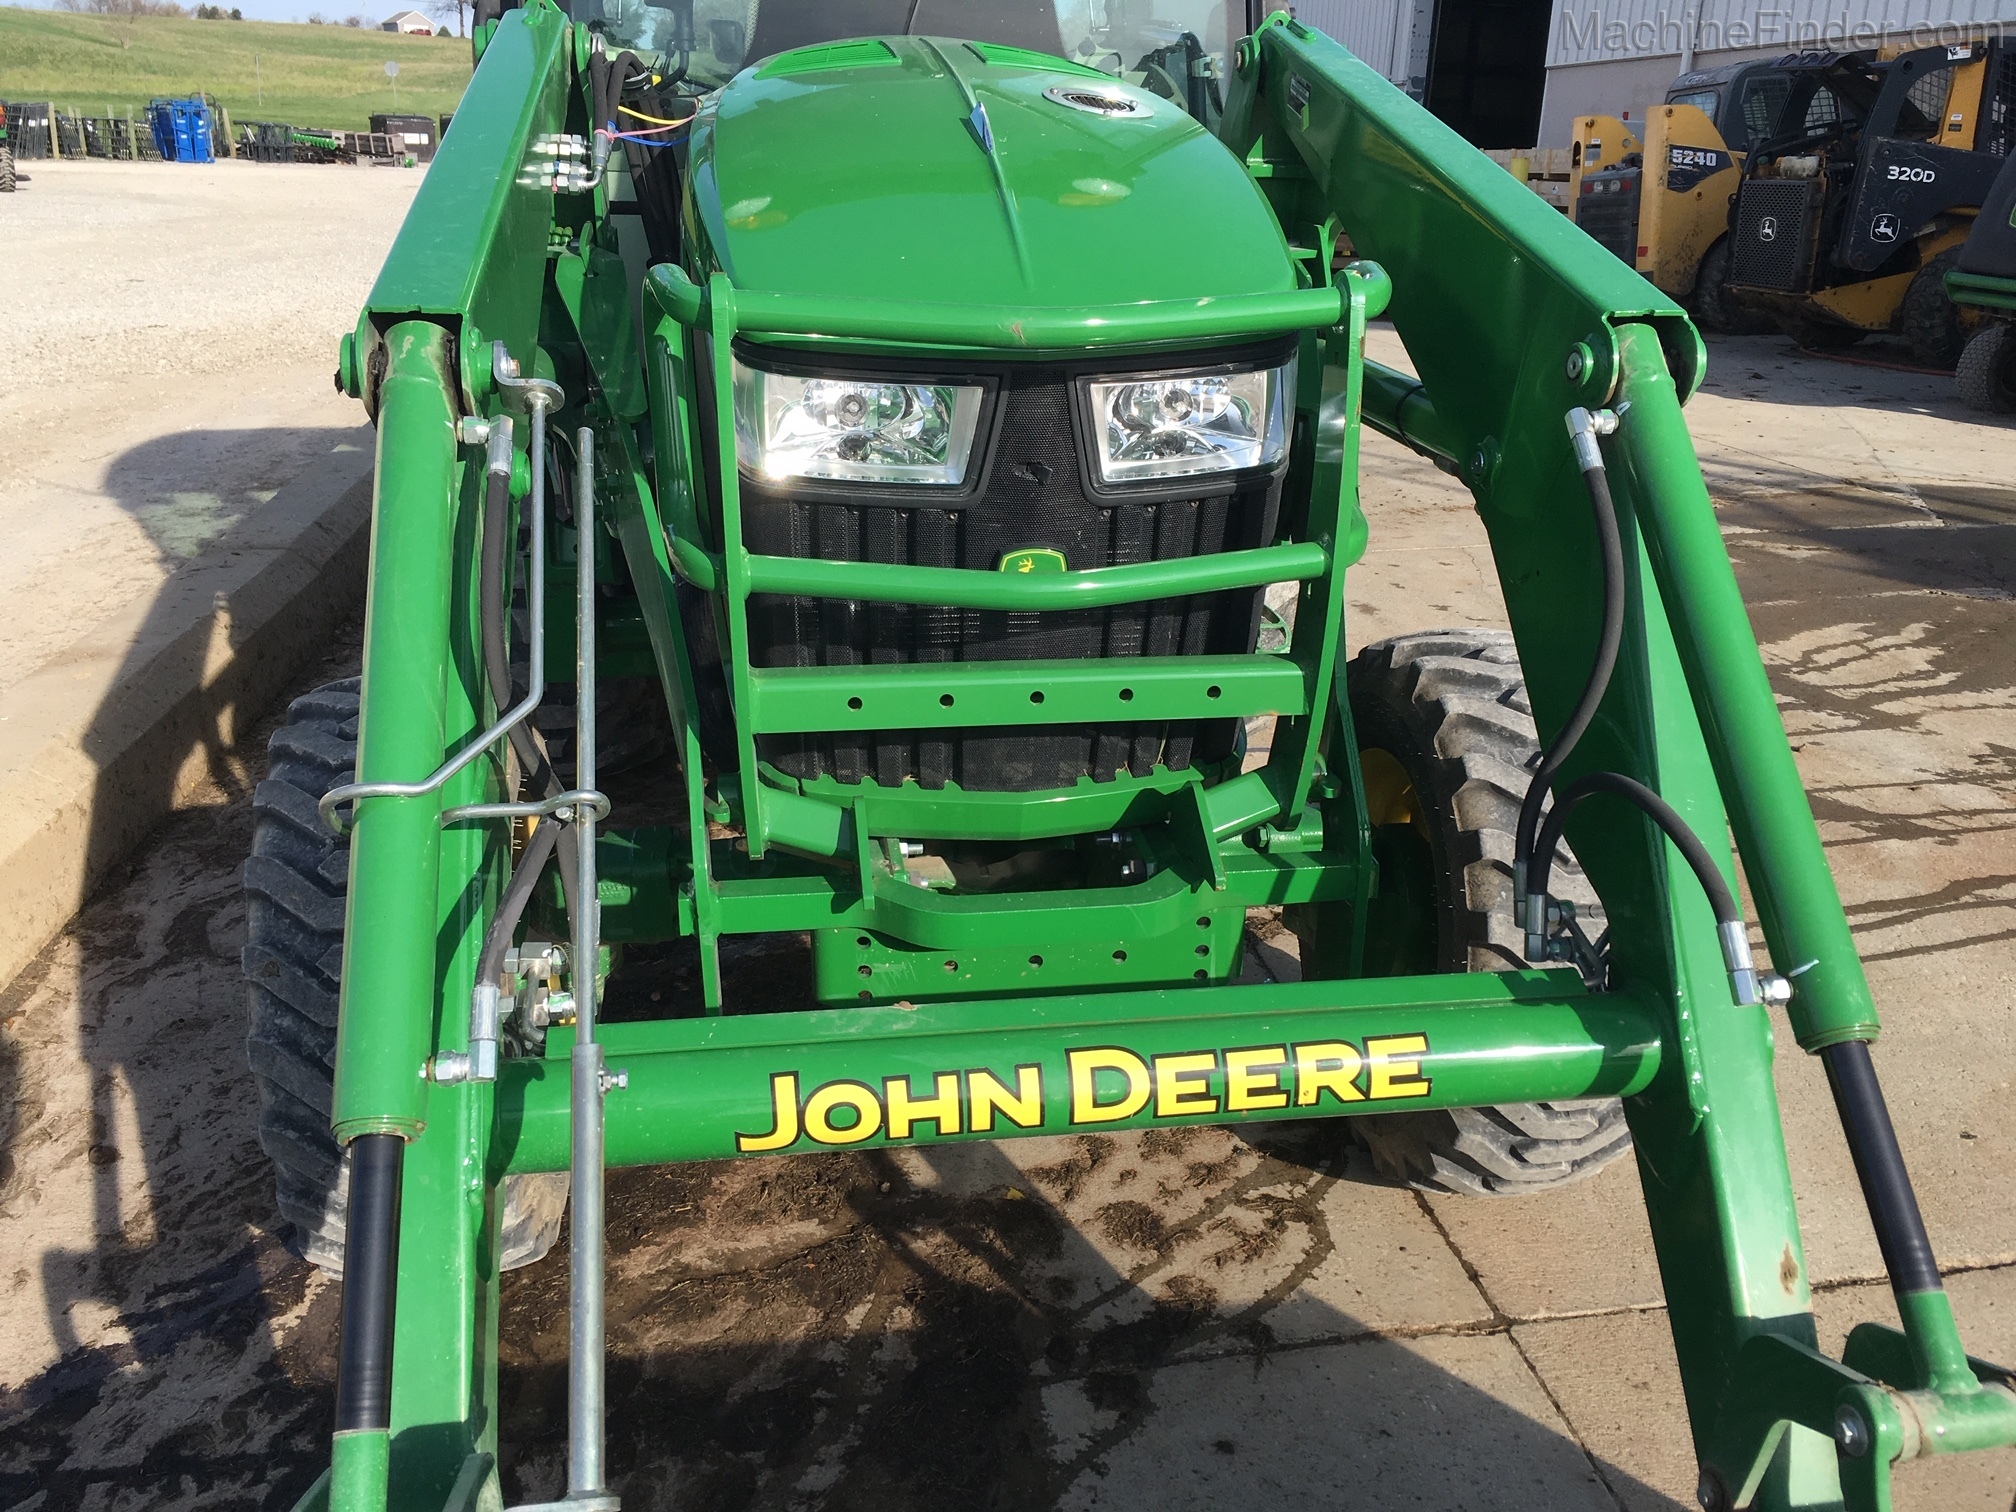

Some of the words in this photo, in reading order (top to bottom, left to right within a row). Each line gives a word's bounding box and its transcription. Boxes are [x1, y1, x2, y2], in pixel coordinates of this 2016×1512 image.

[1672, 149, 1717, 166] 5240
[1887, 165, 1936, 183] 320D
[735, 1062, 1045, 1152] JOHN
[1065, 1032, 1433, 1126] DEERE
